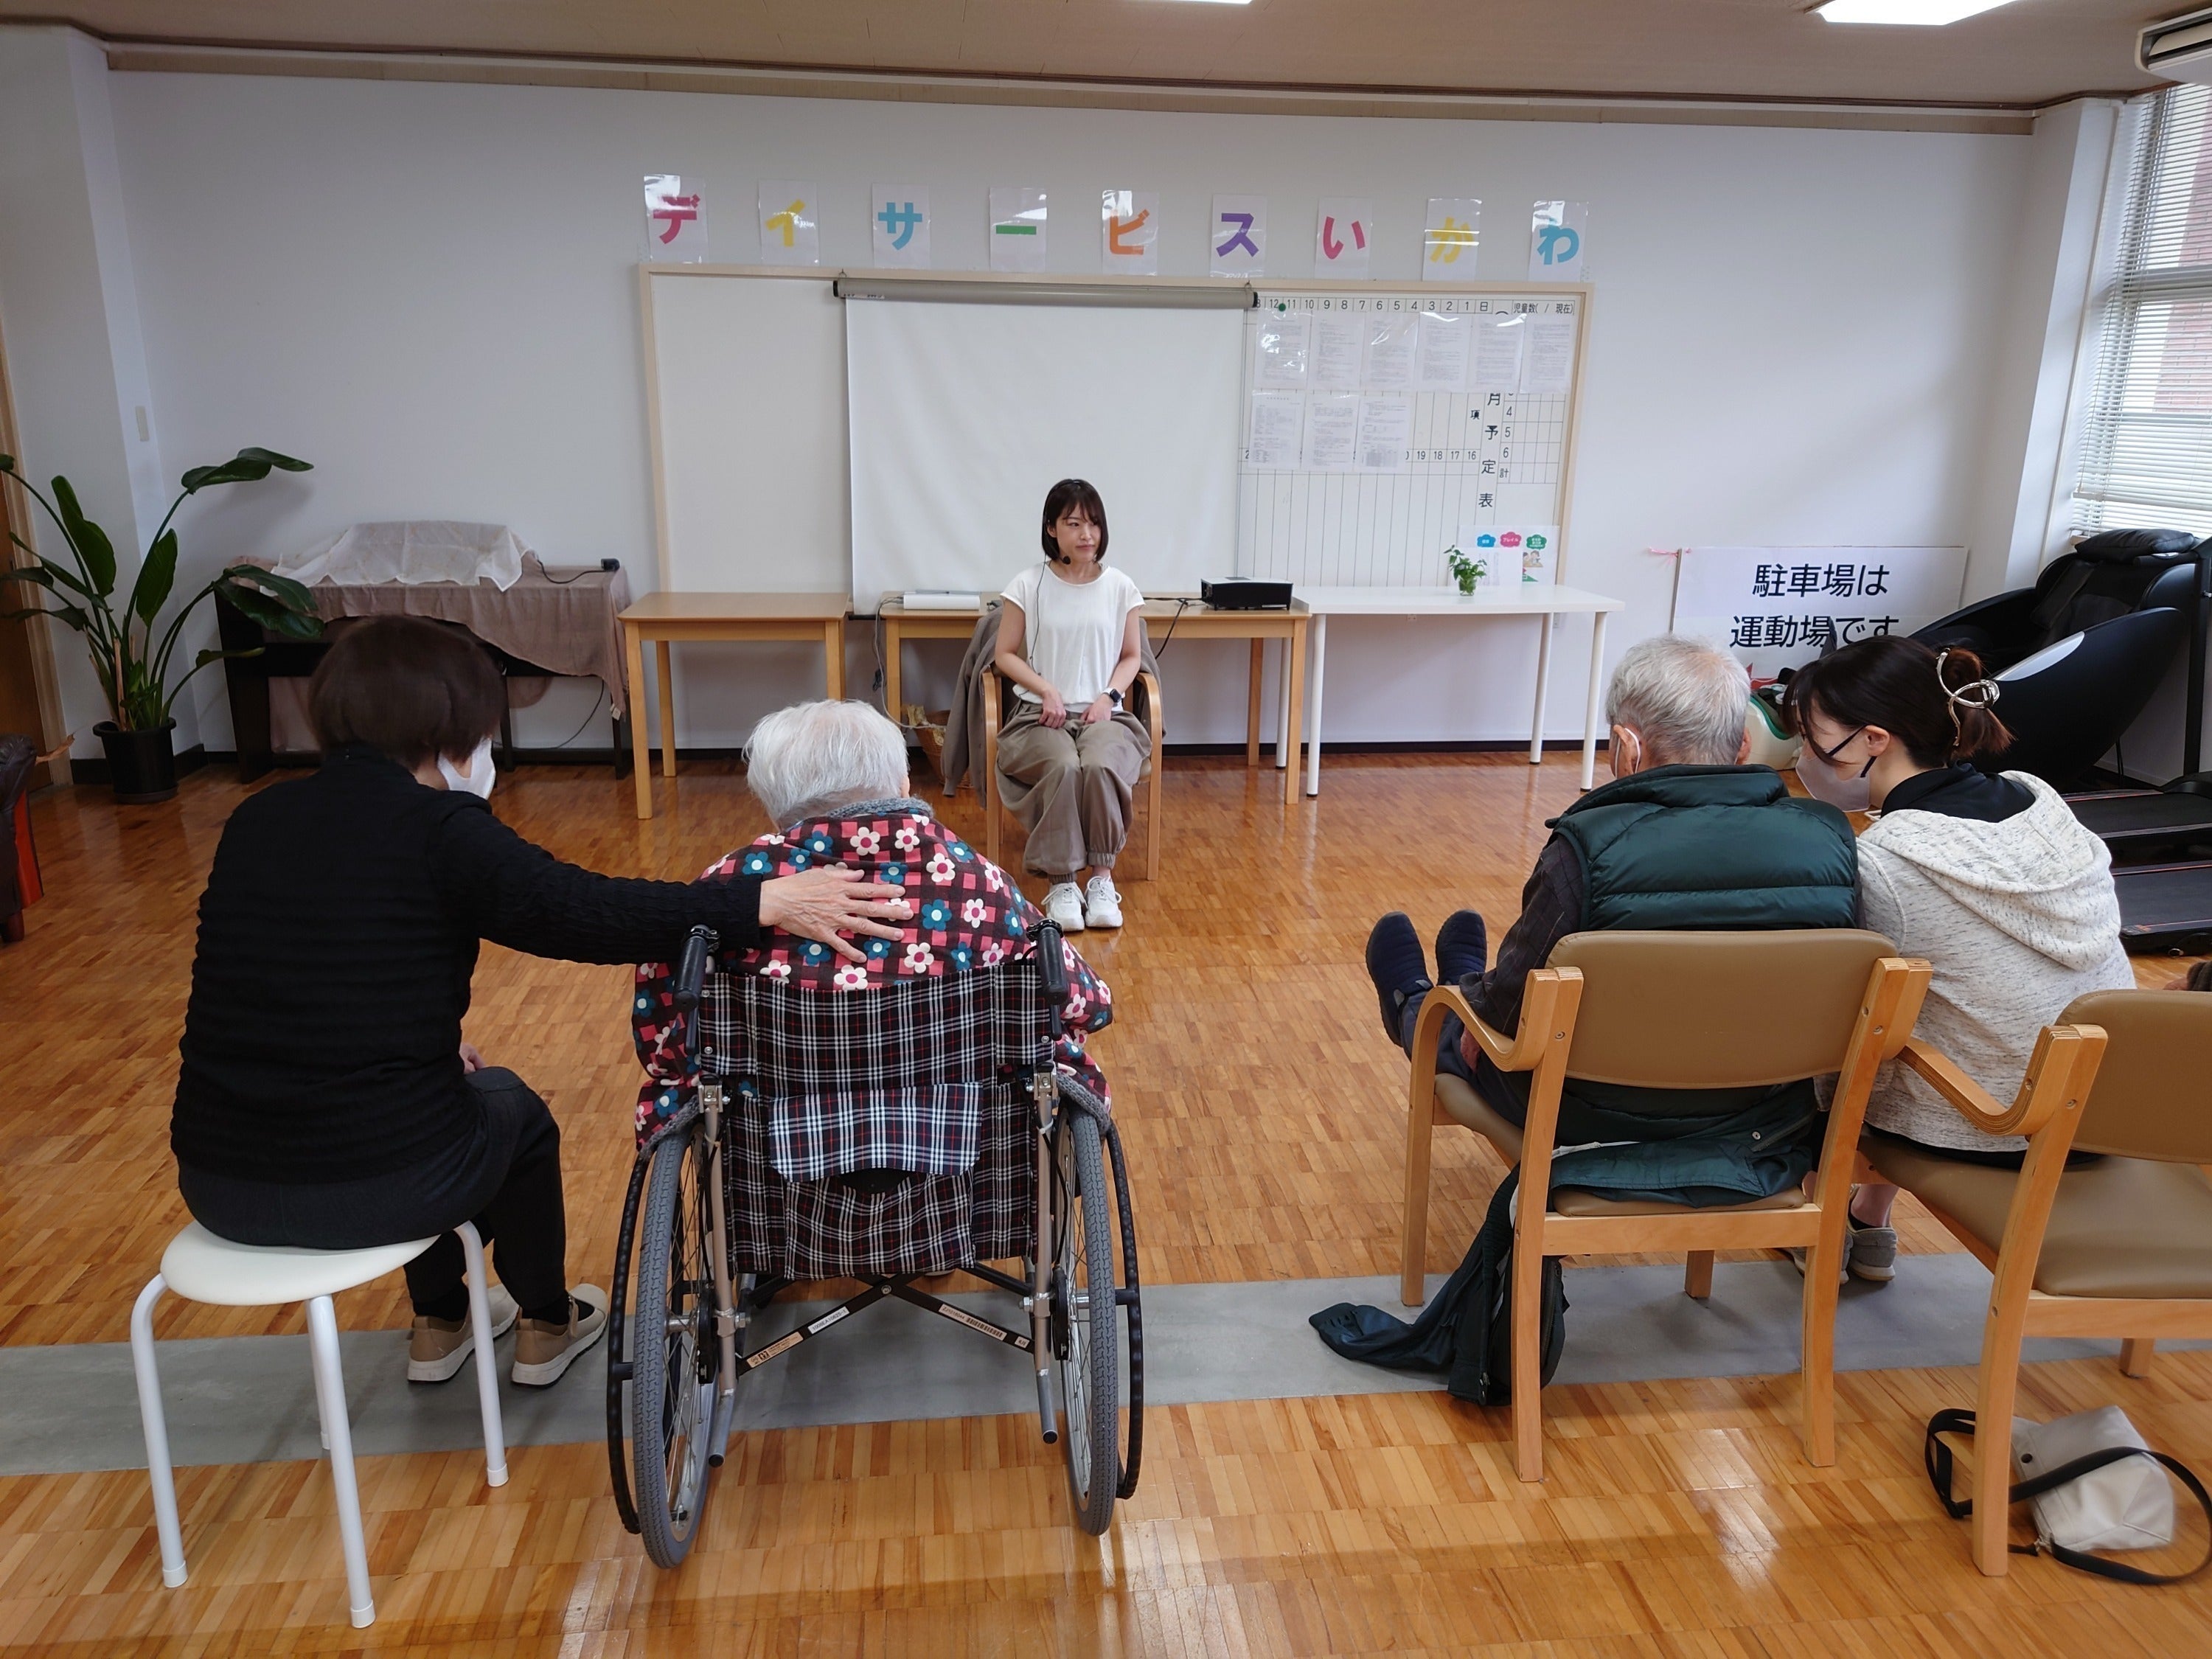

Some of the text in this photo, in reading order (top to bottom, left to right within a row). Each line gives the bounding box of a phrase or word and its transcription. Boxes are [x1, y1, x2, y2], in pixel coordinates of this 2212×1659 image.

[1270, 299, 1279, 308] 12
[1287, 299, 1296, 309] 11
[1305, 299, 1314, 309] 10
[1324, 299, 1330, 310] 9
[1341, 300, 1348, 310] 8
[1359, 300, 1366, 310] 7
[1377, 301, 1382, 310] 6
[1394, 301, 1400, 310] 5
[1411, 302, 1417, 310] 4
[1428, 302, 1435, 310] 3
[1446, 302, 1453, 310] 2
[1465, 302, 1469, 310] 1
[1480, 302, 1488, 312] 日
[1506, 406, 1512, 417] 4
[1504, 426, 1511, 438] 5
[1417, 451, 1426, 460] 19
[1433, 451, 1443, 460] 18
[1451, 451, 1460, 460] 17
[1468, 451, 1476, 460] 16
[1503, 447, 1509, 458] 6
[1499, 467, 1509, 479] 計
[1752, 563, 1891, 598] 駐車場は
